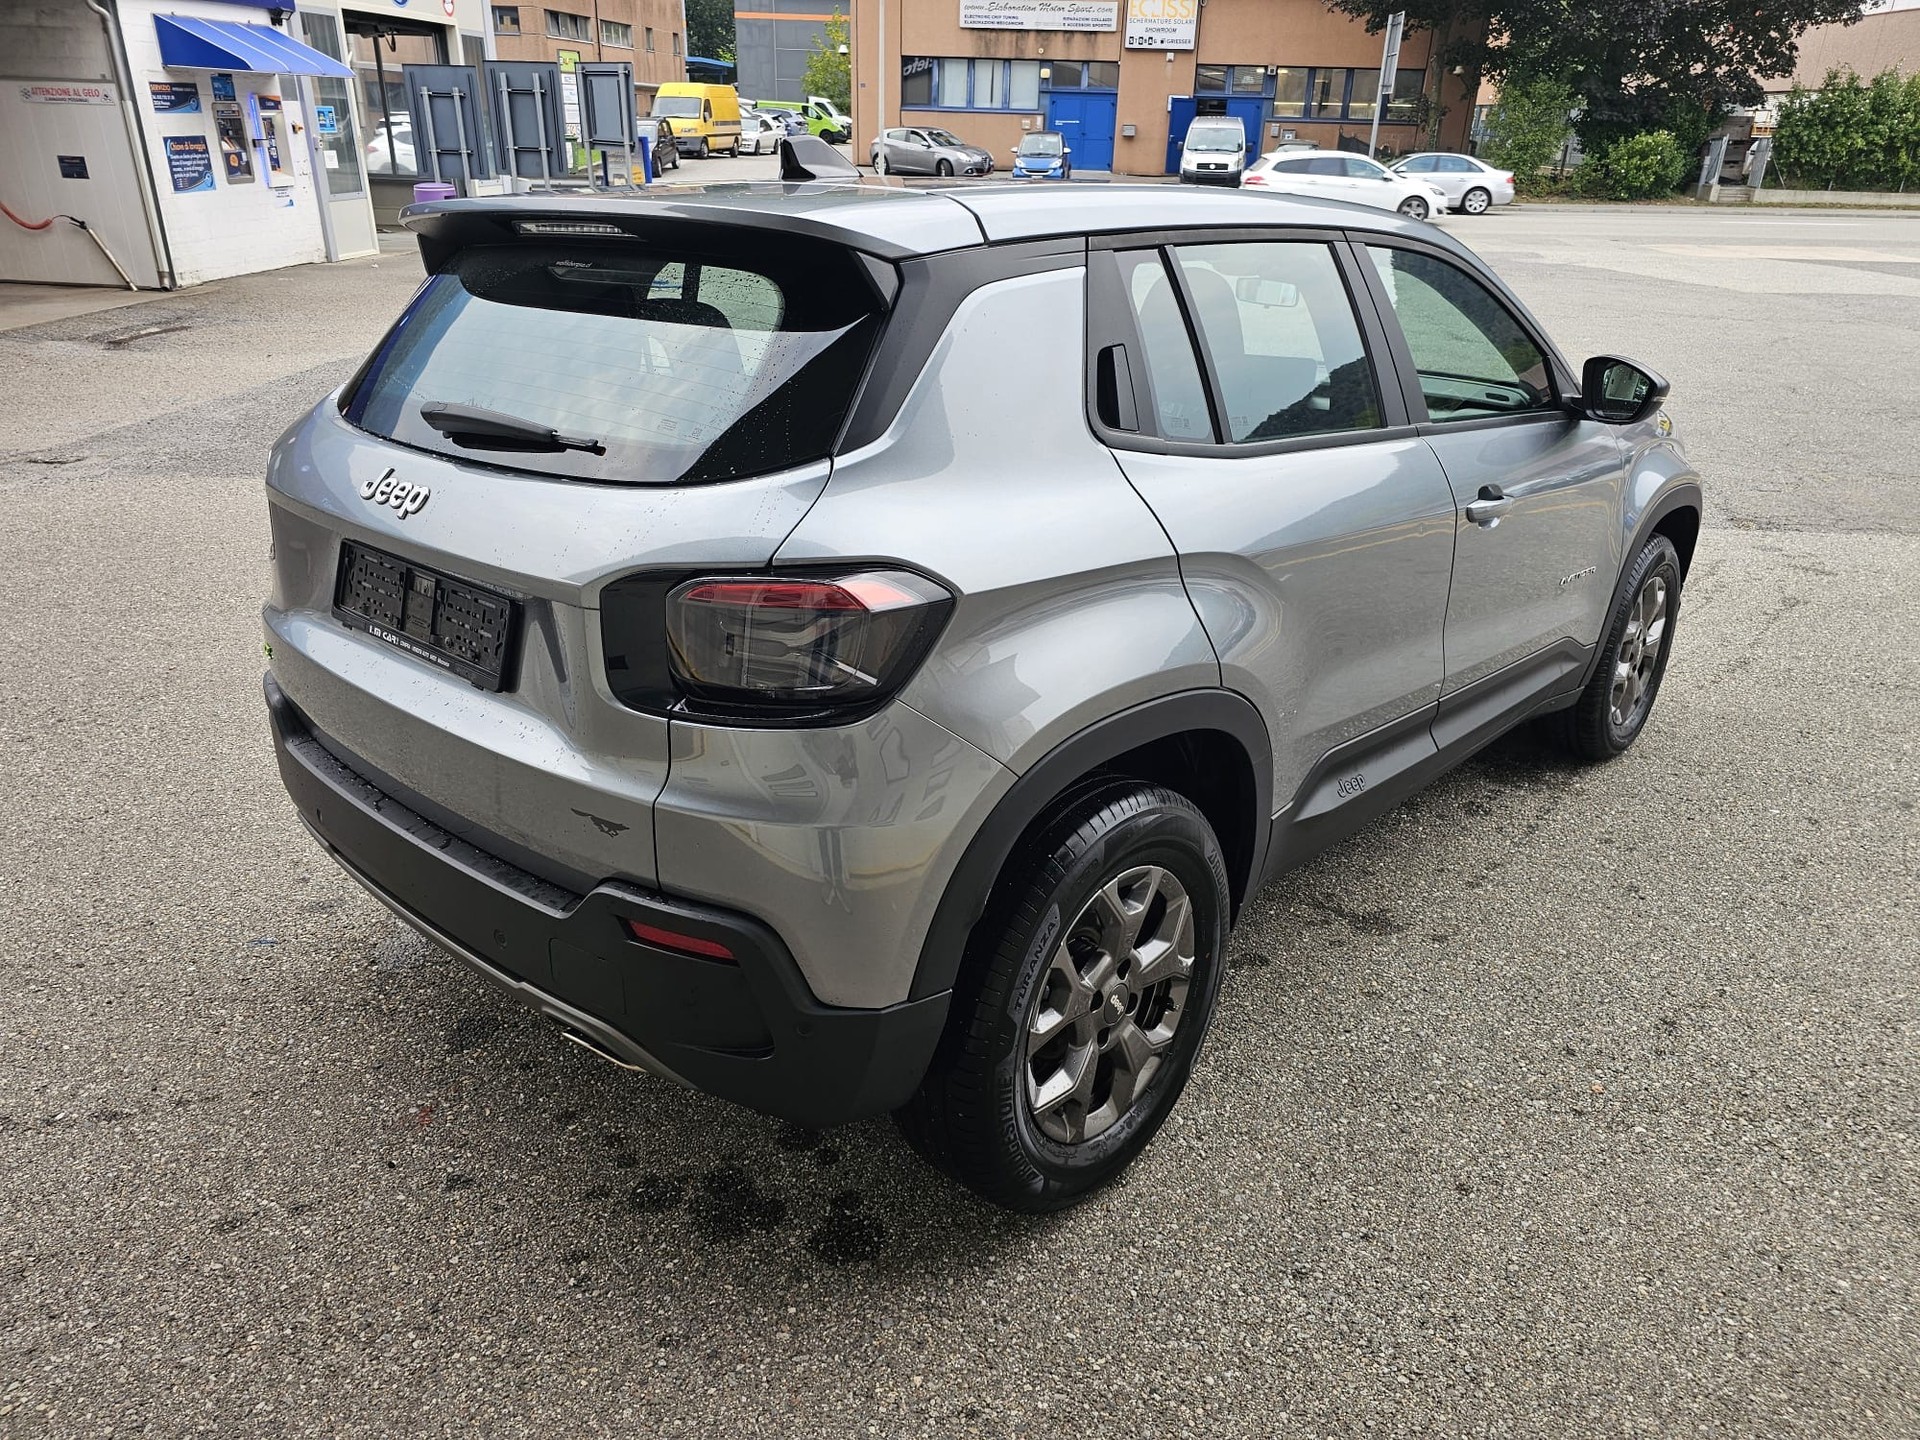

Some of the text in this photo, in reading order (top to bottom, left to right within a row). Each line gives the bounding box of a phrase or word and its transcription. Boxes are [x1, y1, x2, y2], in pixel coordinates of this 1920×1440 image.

[1038, 3, 1065, 12] Motor
[31, 86, 99, 98] ATTENZIONE AL GELO
[360, 468, 431, 520] Jeep
[1337, 773, 1365, 798] Jeep
[1015, 922, 1056, 1010] TURANZA
